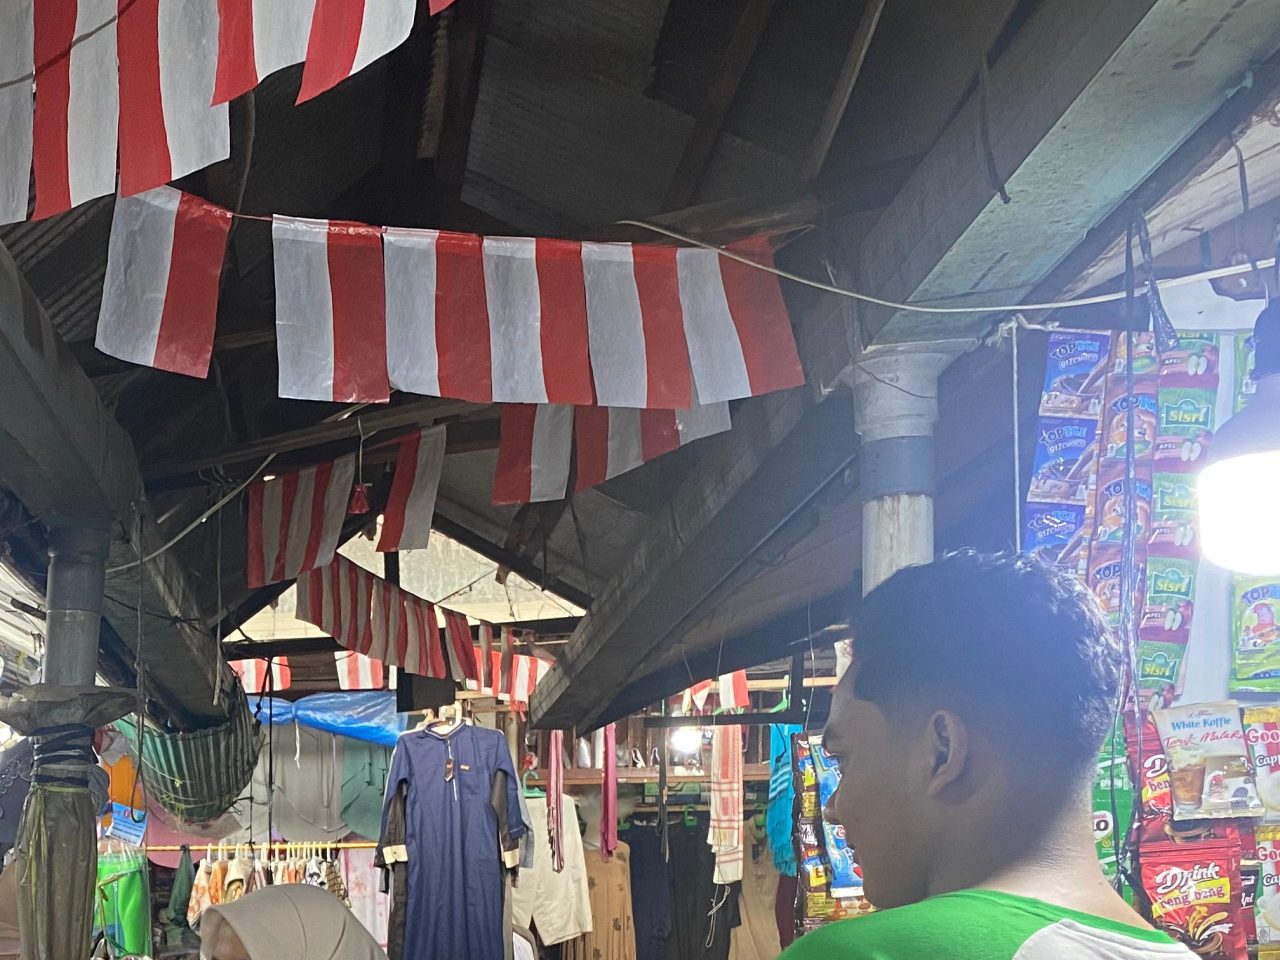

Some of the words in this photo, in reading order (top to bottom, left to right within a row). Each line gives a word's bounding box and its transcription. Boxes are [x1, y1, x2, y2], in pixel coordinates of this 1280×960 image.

[1051, 342, 1077, 360] TOP
[1040, 427, 1064, 447] TOP
[1171, 721, 1200, 731] White
[1203, 717, 1232, 729] Koffie
[1148, 779, 1169, 792] ben
[1155, 861, 1220, 894] Drink
